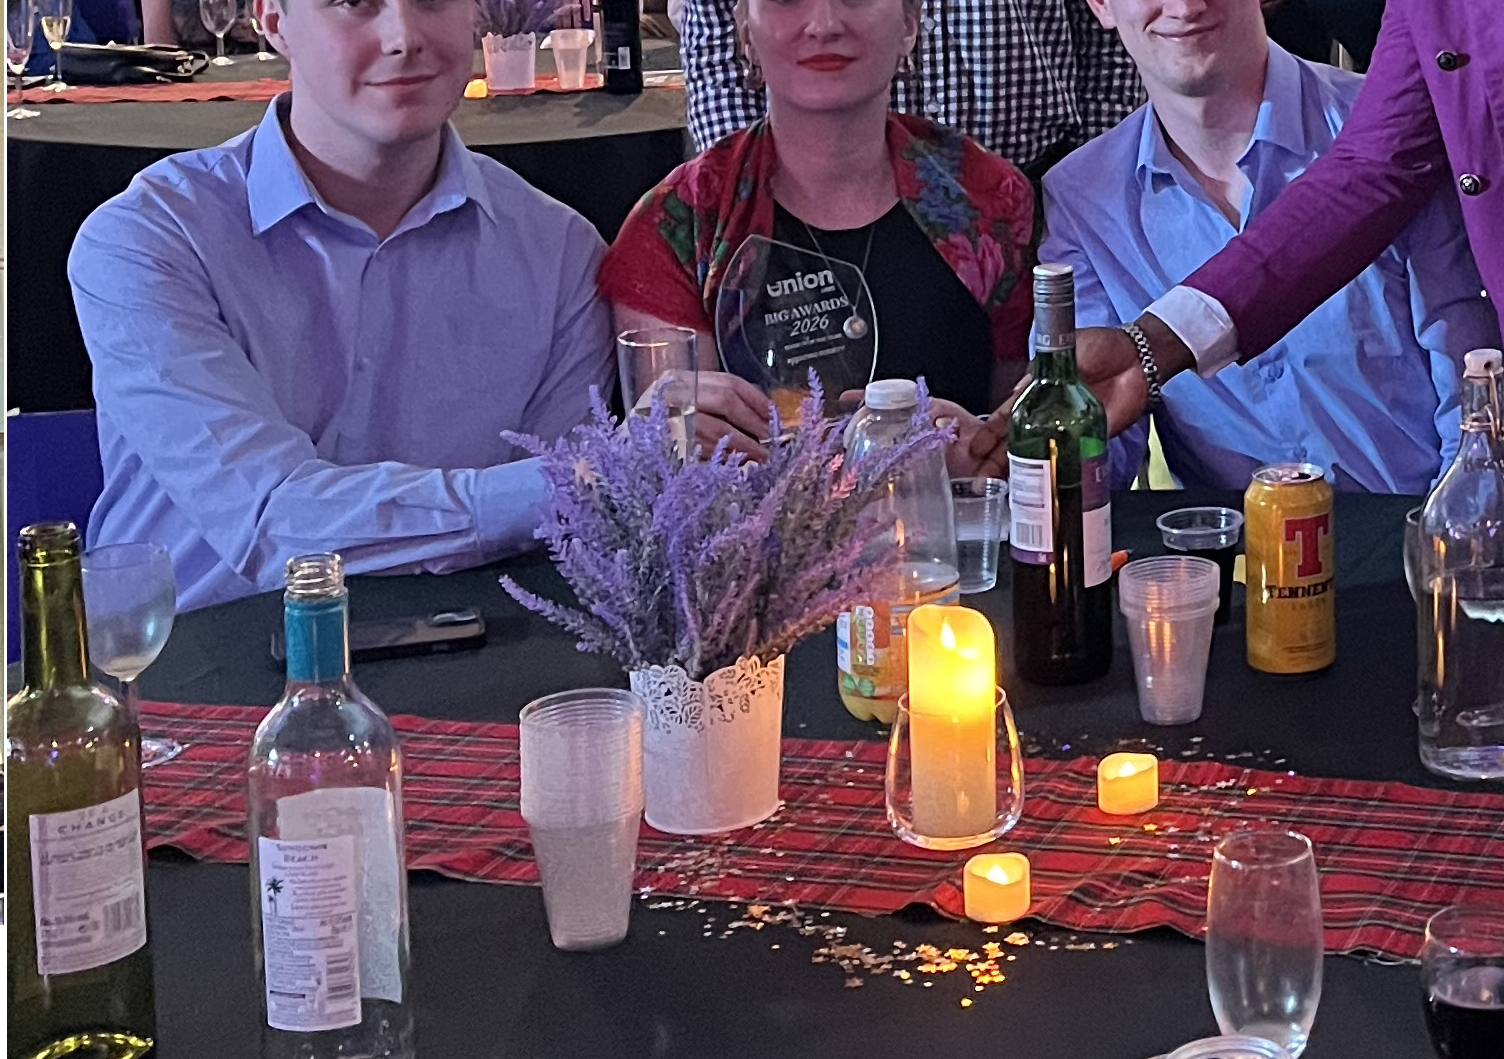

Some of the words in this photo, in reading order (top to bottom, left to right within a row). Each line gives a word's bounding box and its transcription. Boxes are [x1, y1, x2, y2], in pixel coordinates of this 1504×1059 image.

[766, 269, 834, 298] union
[789, 313, 830, 337] 2026
[1284, 514, 1329, 578] T
[57, 809, 125, 835] CHANGE
